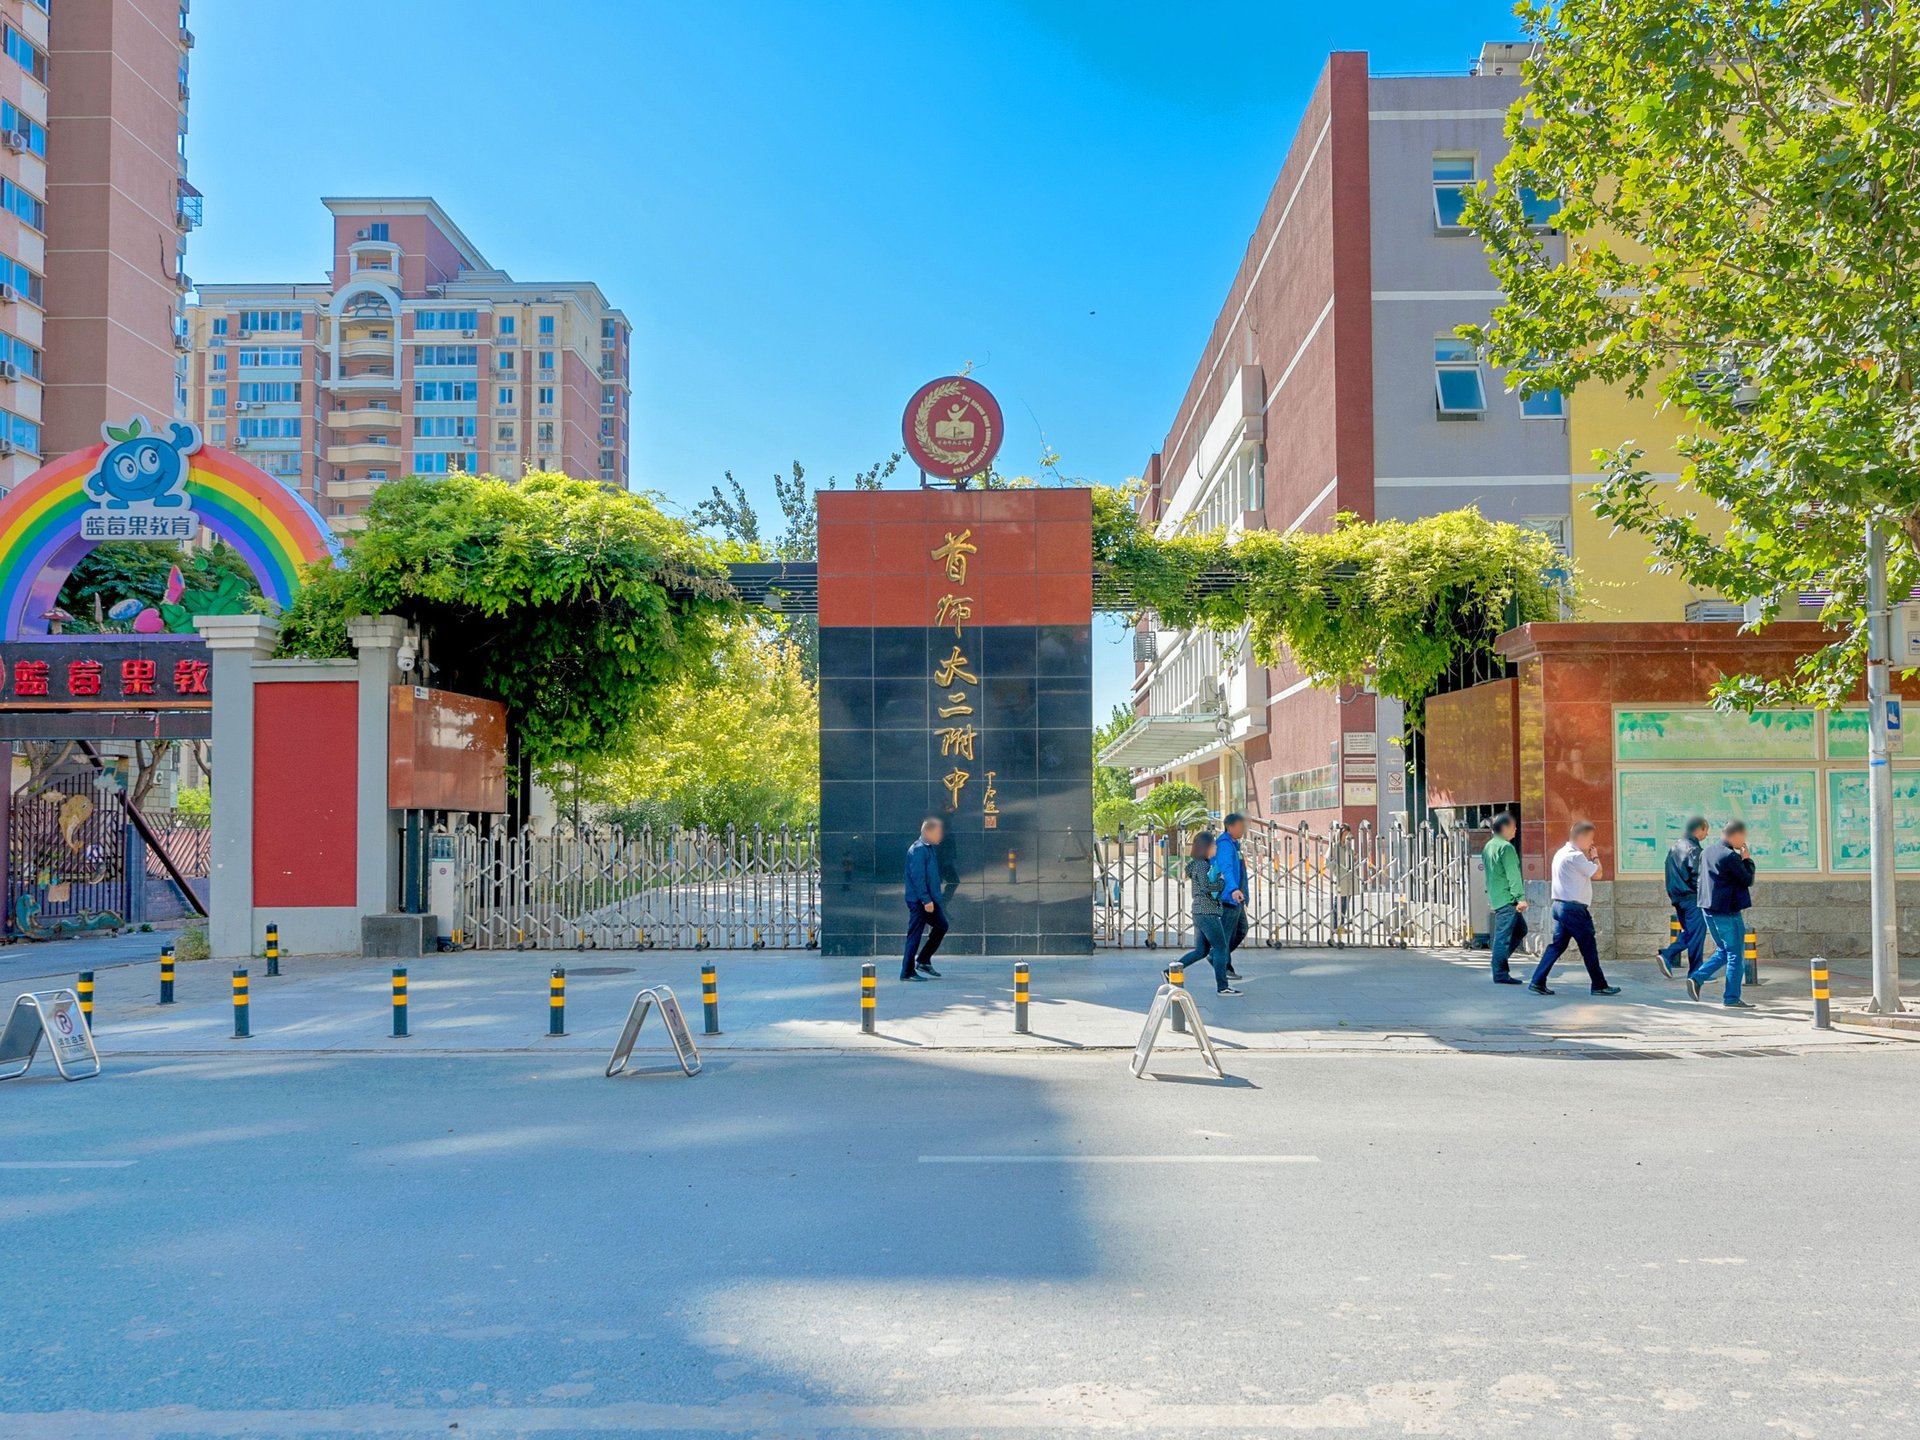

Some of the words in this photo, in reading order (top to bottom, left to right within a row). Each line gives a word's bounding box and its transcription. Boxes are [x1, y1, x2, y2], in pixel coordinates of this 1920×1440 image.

[86, 516, 191, 536] 蓝莓果教育
[930, 528, 979, 809] 首师大二附中
